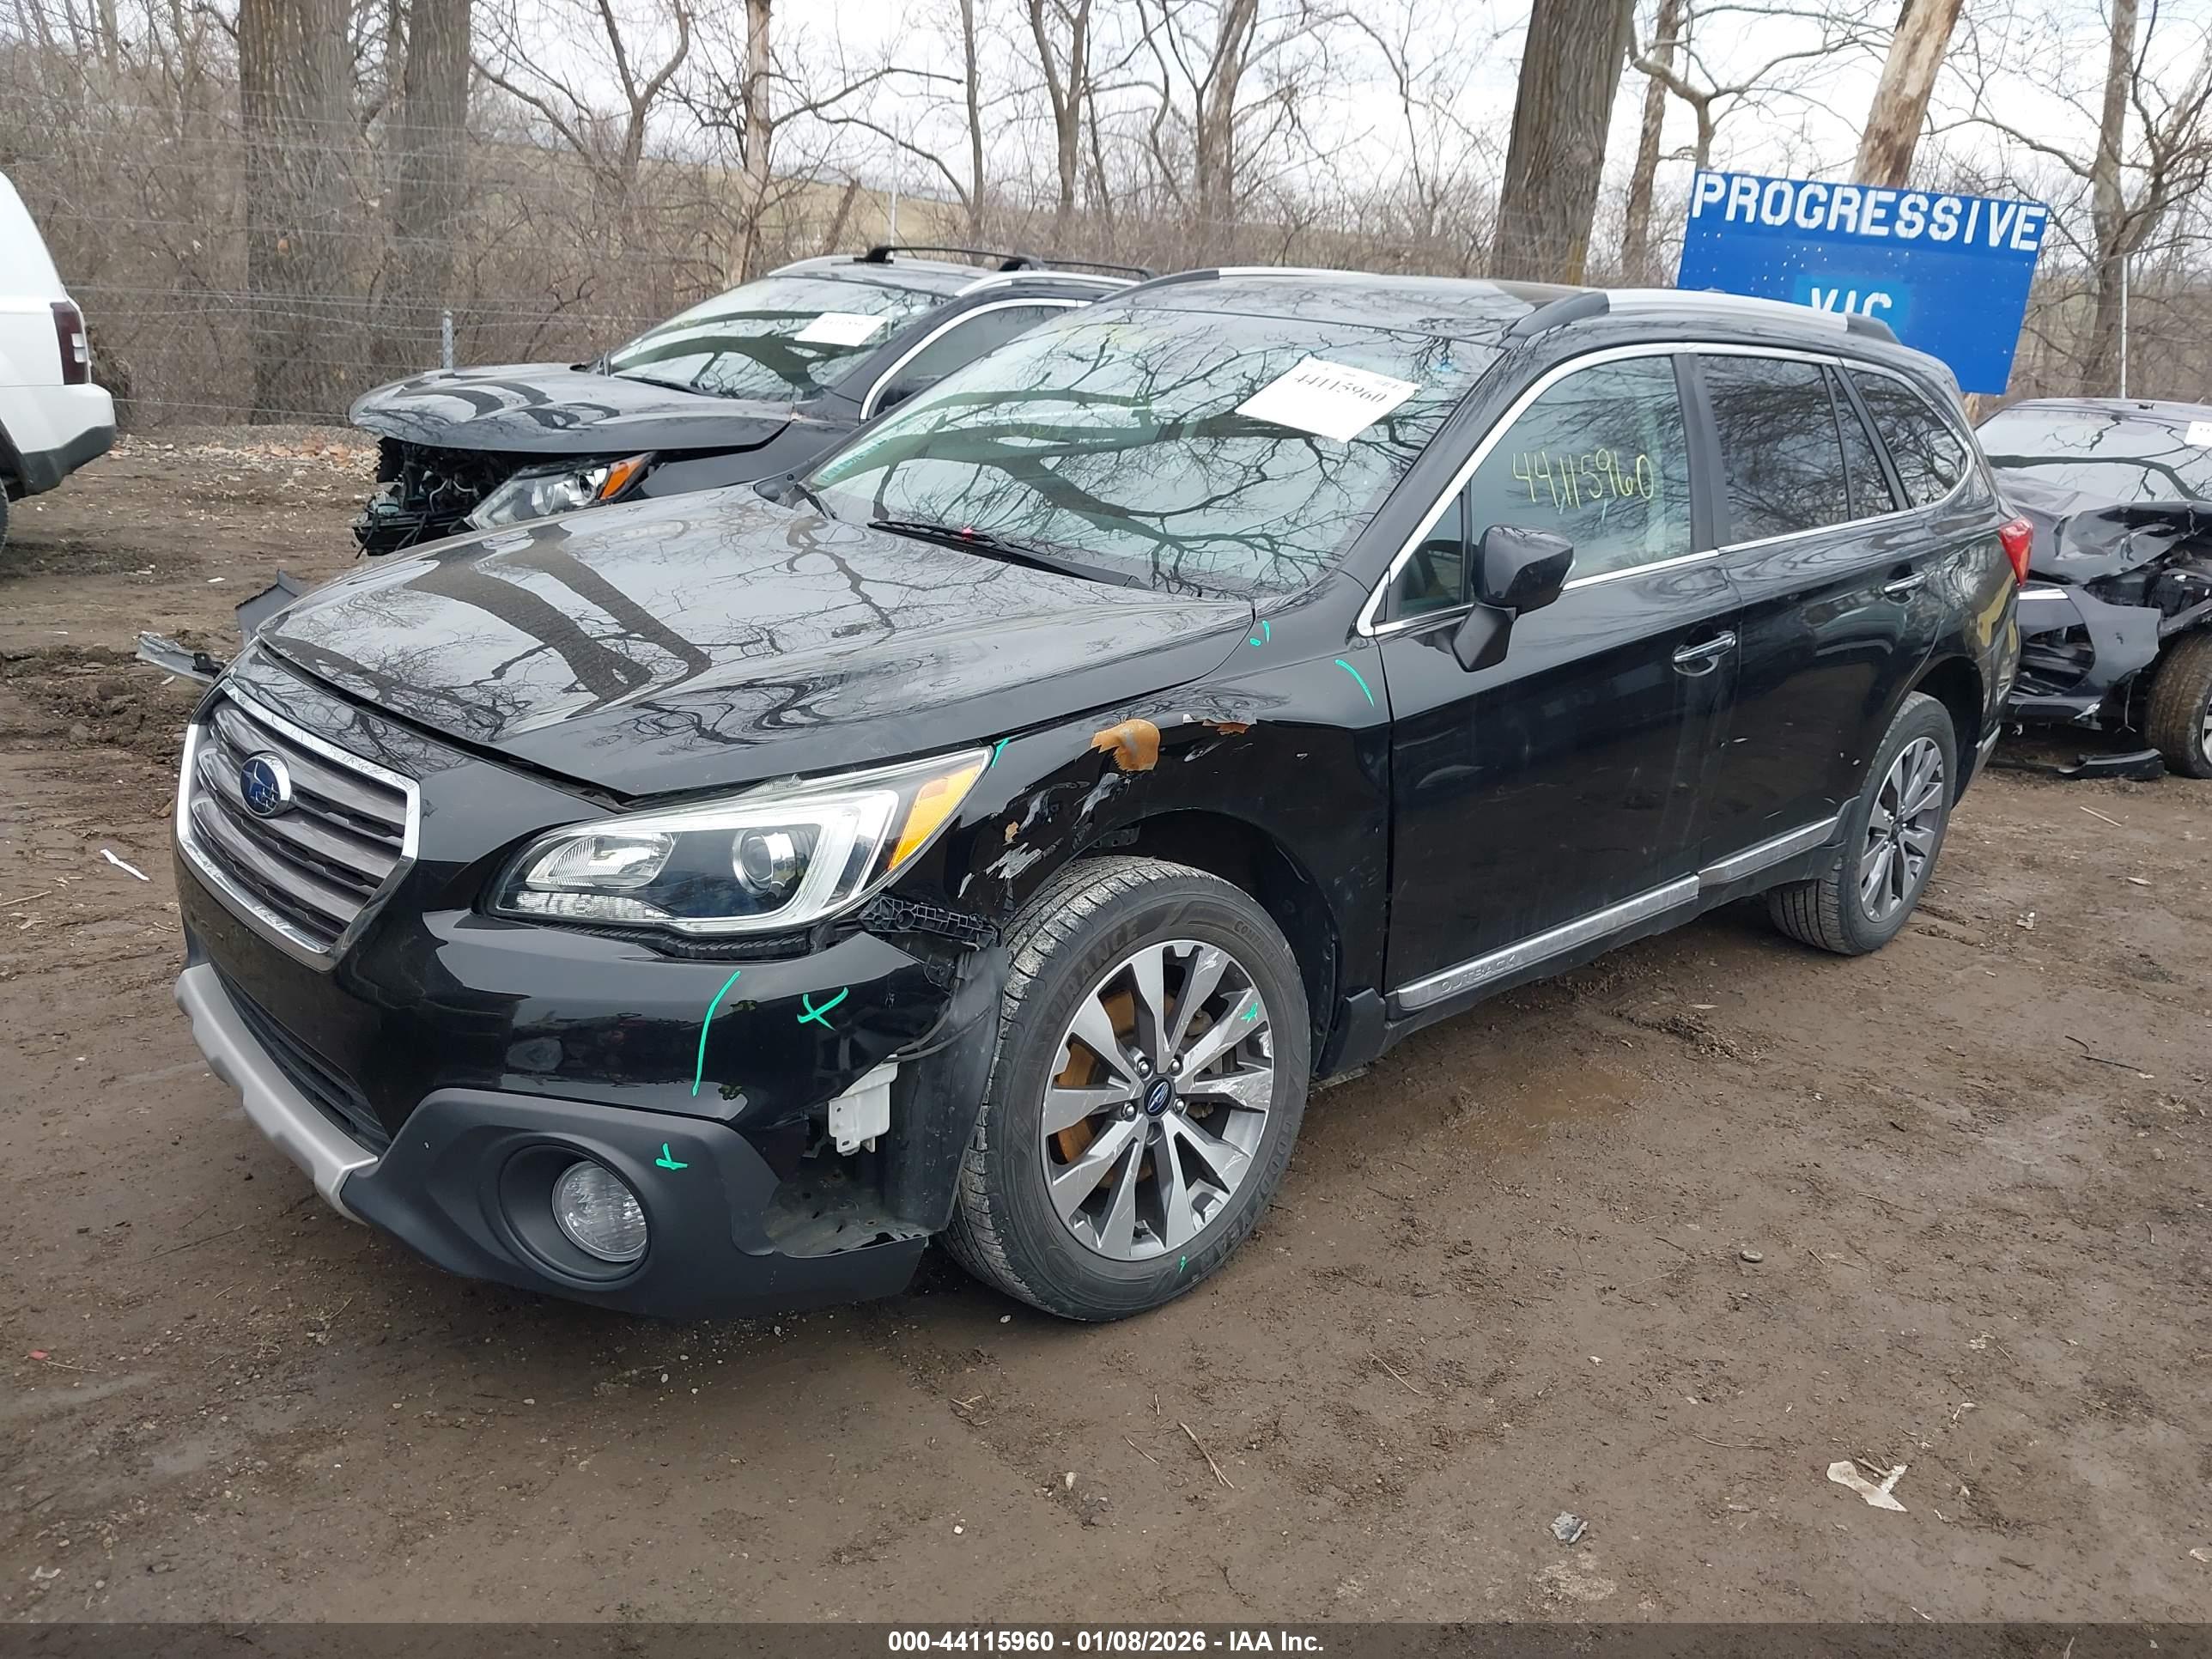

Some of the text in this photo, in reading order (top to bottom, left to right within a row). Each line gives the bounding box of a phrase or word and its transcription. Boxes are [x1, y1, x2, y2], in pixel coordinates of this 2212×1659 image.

[1692, 173, 2047, 252] PROGRESSIVE
[1512, 448, 1654, 508] 44115960
[1440, 954, 1516, 994] OUTBACK
